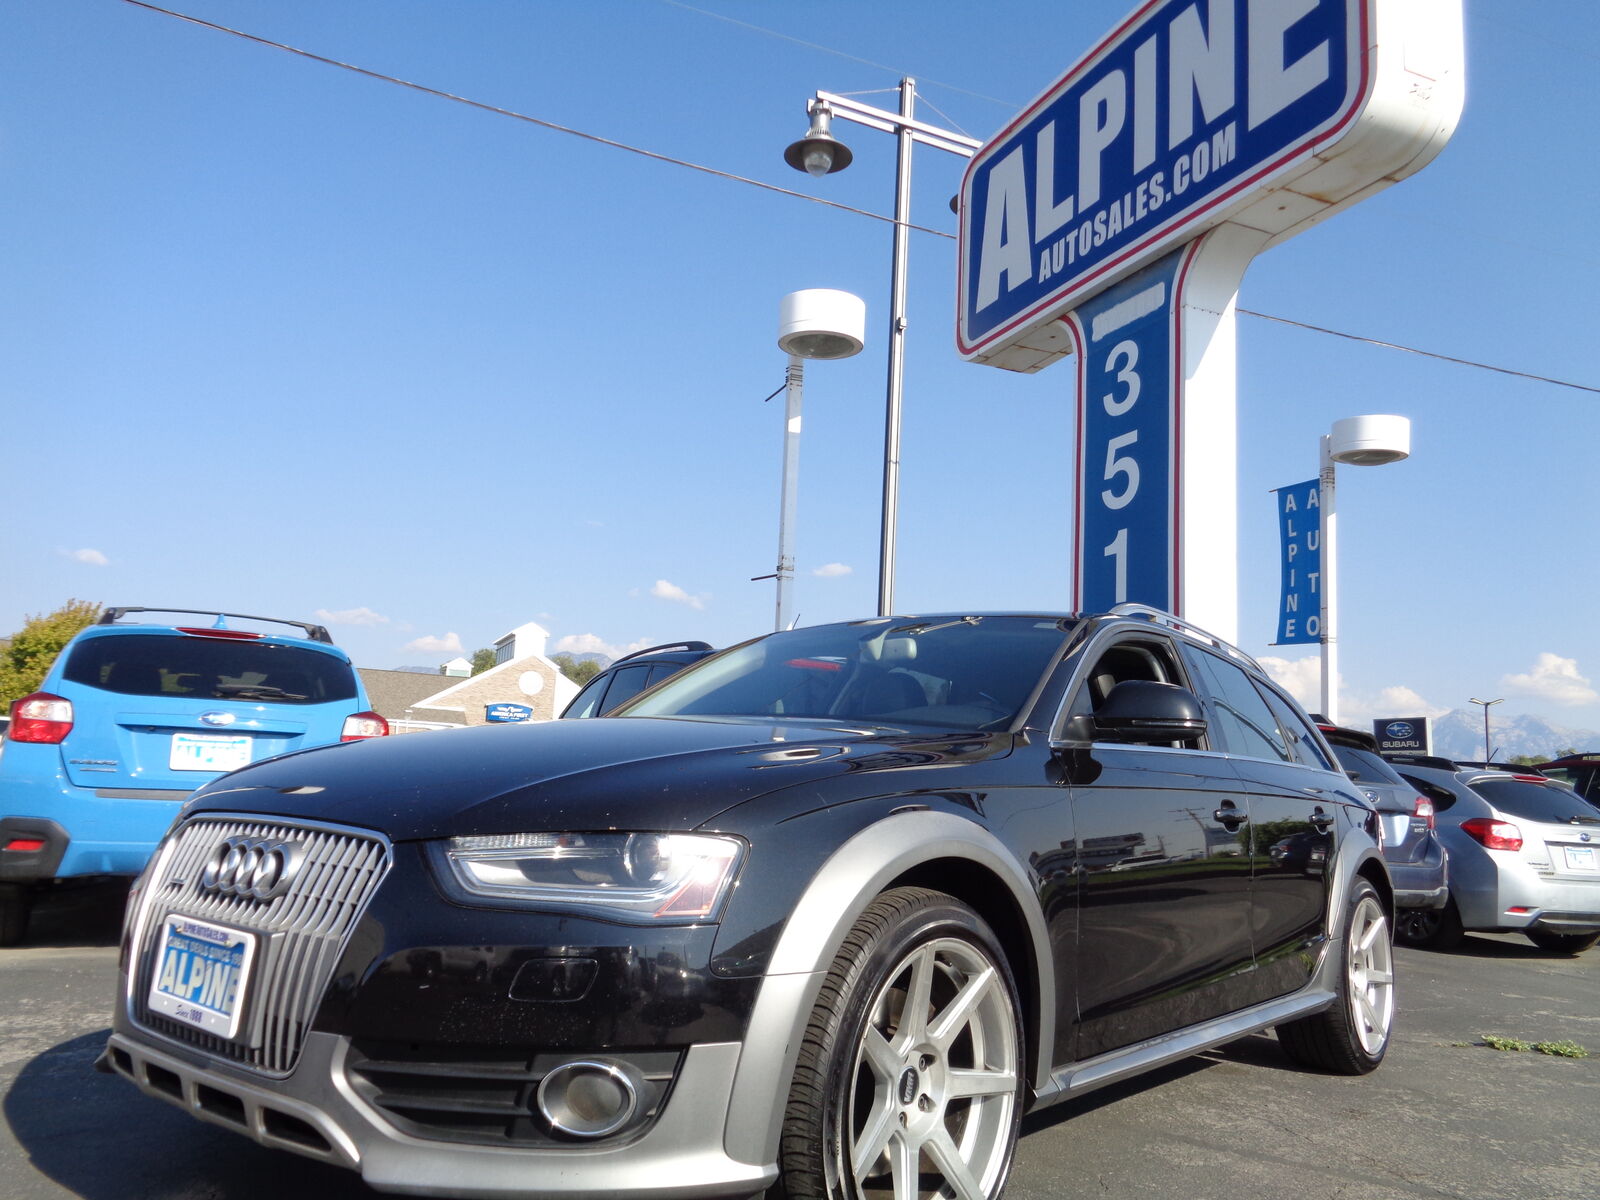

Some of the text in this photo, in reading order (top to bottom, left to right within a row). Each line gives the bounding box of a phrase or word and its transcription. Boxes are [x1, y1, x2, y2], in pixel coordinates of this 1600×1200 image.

[976, 0, 1330, 314] ALPINE
[1038, 121, 1237, 285] AUTOSALES.COM
[1285, 494, 1298, 639] ALPINE
[1306, 488, 1321, 637] AUTO
[1382, 740, 1419, 748] SUBARU
[159, 949, 240, 1015] ALPINE
